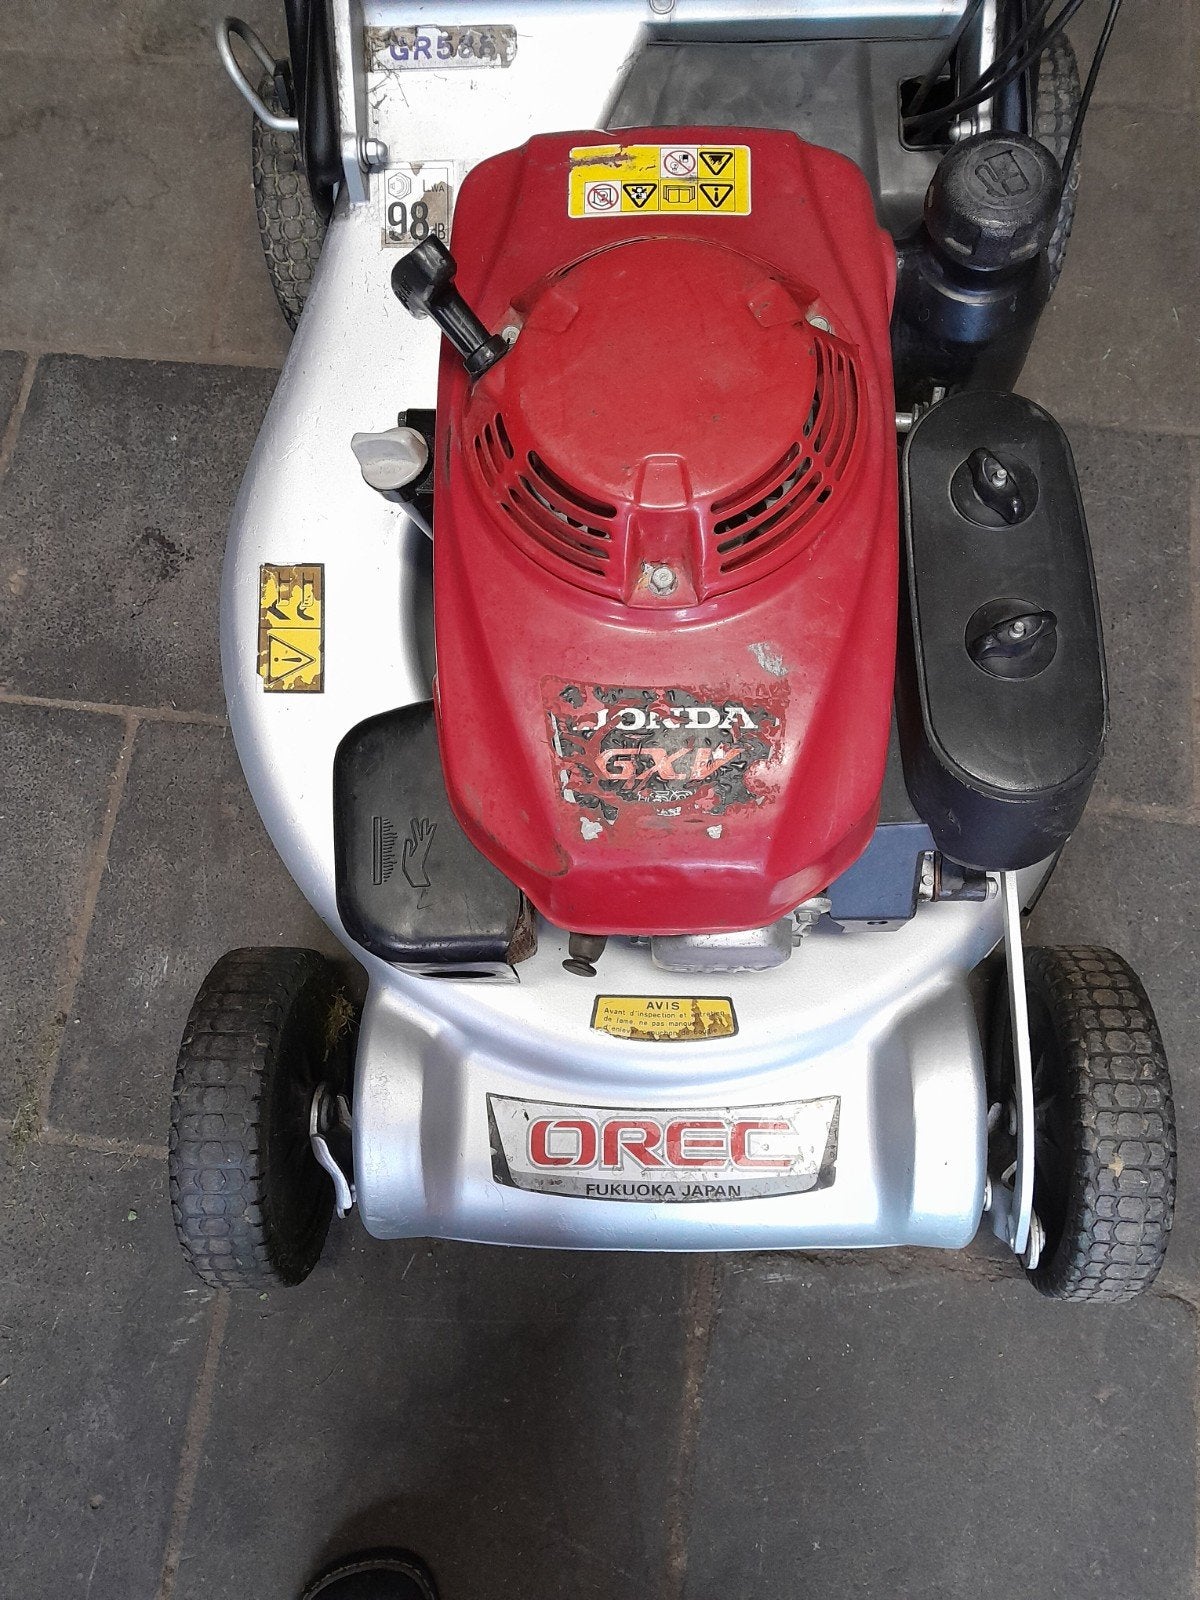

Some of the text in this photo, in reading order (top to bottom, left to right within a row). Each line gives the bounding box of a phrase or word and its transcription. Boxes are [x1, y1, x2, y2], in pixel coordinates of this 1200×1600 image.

[388, 201, 429, 241] 98
[646, 1001, 680, 1010] AVIS
[603, 1015, 613, 1023] de
[604, 1007, 626, 1016] Avant
[629, 1010, 676, 1019] d'inspection
[529, 1120, 794, 1168] OREC
[585, 1183, 742, 1198] FUKUOKA JAPAN
